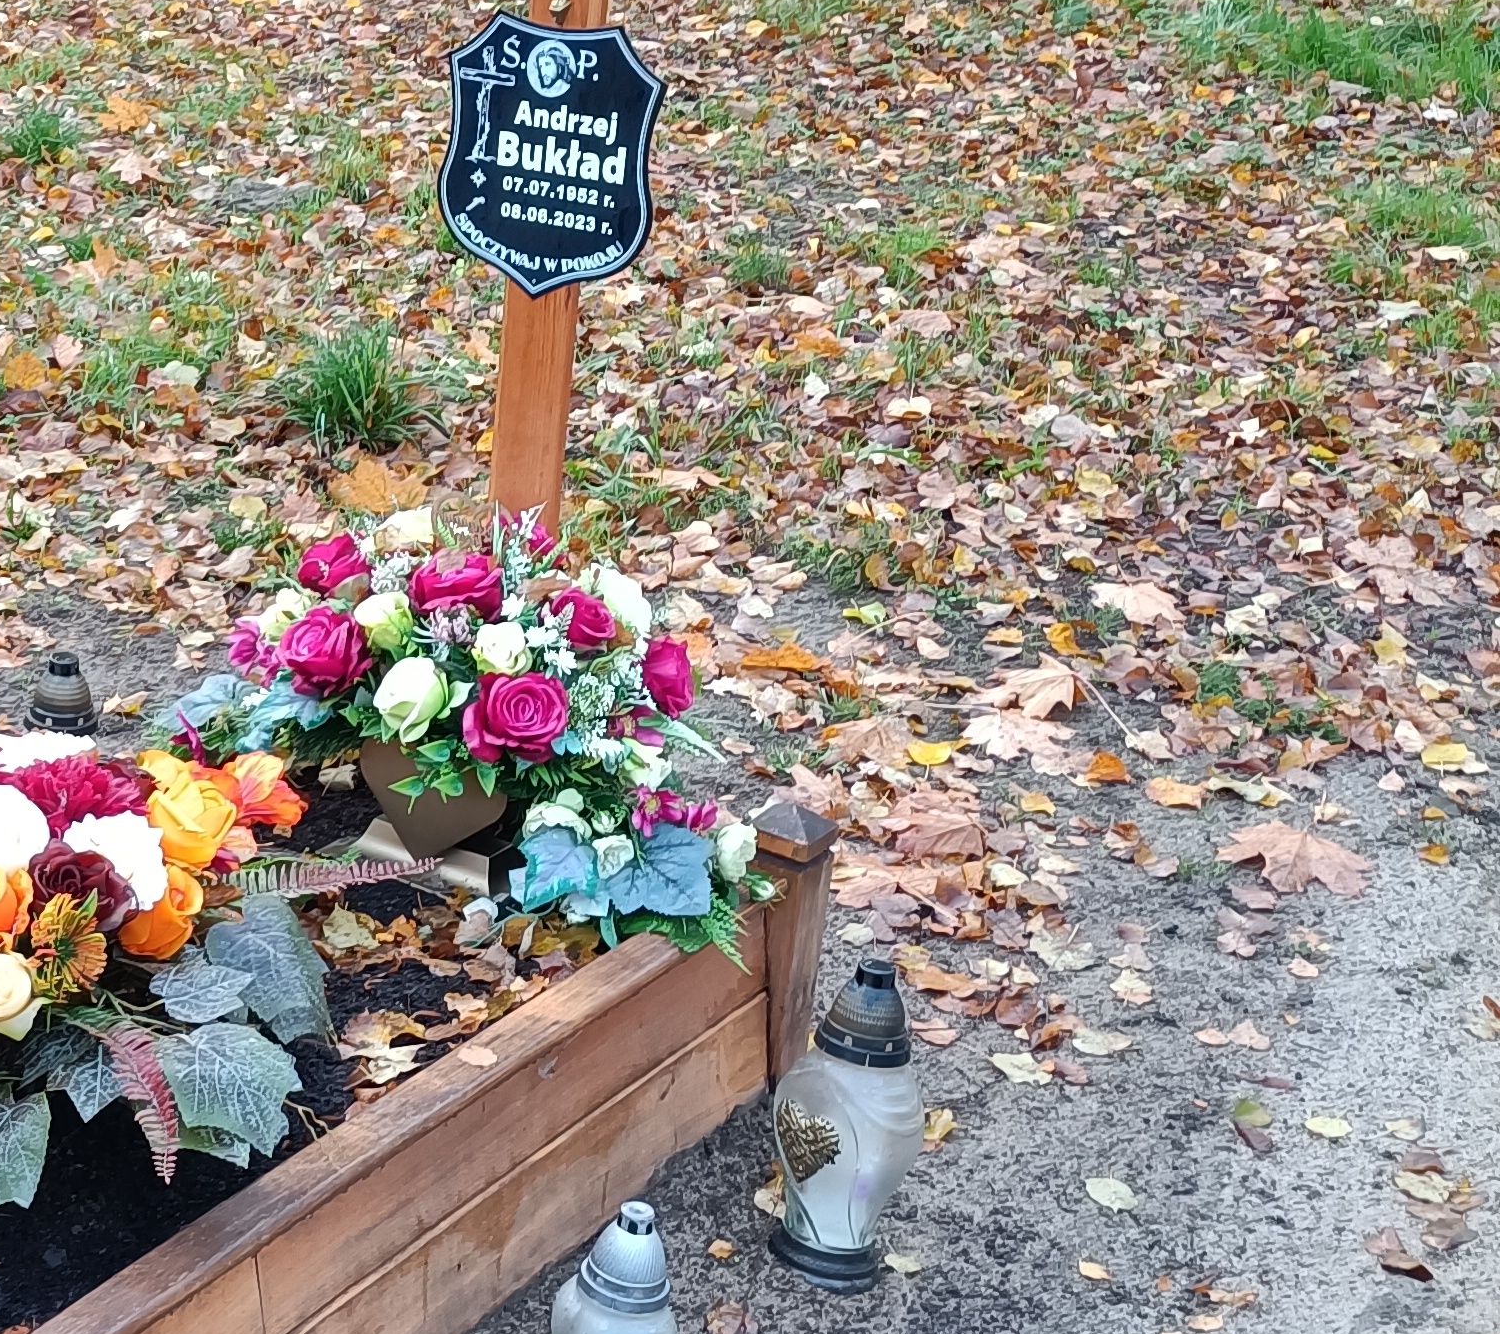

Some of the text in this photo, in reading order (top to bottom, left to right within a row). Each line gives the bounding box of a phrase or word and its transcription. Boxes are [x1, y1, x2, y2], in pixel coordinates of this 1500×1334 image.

[513, 100, 618, 146] Andrzej
[496, 130, 627, 185] Bukład
[603, 194, 615, 208] r.
[454, 212, 624, 273] SPOCZYWAJ W POKOJU
[601, 221, 613, 235] r.
